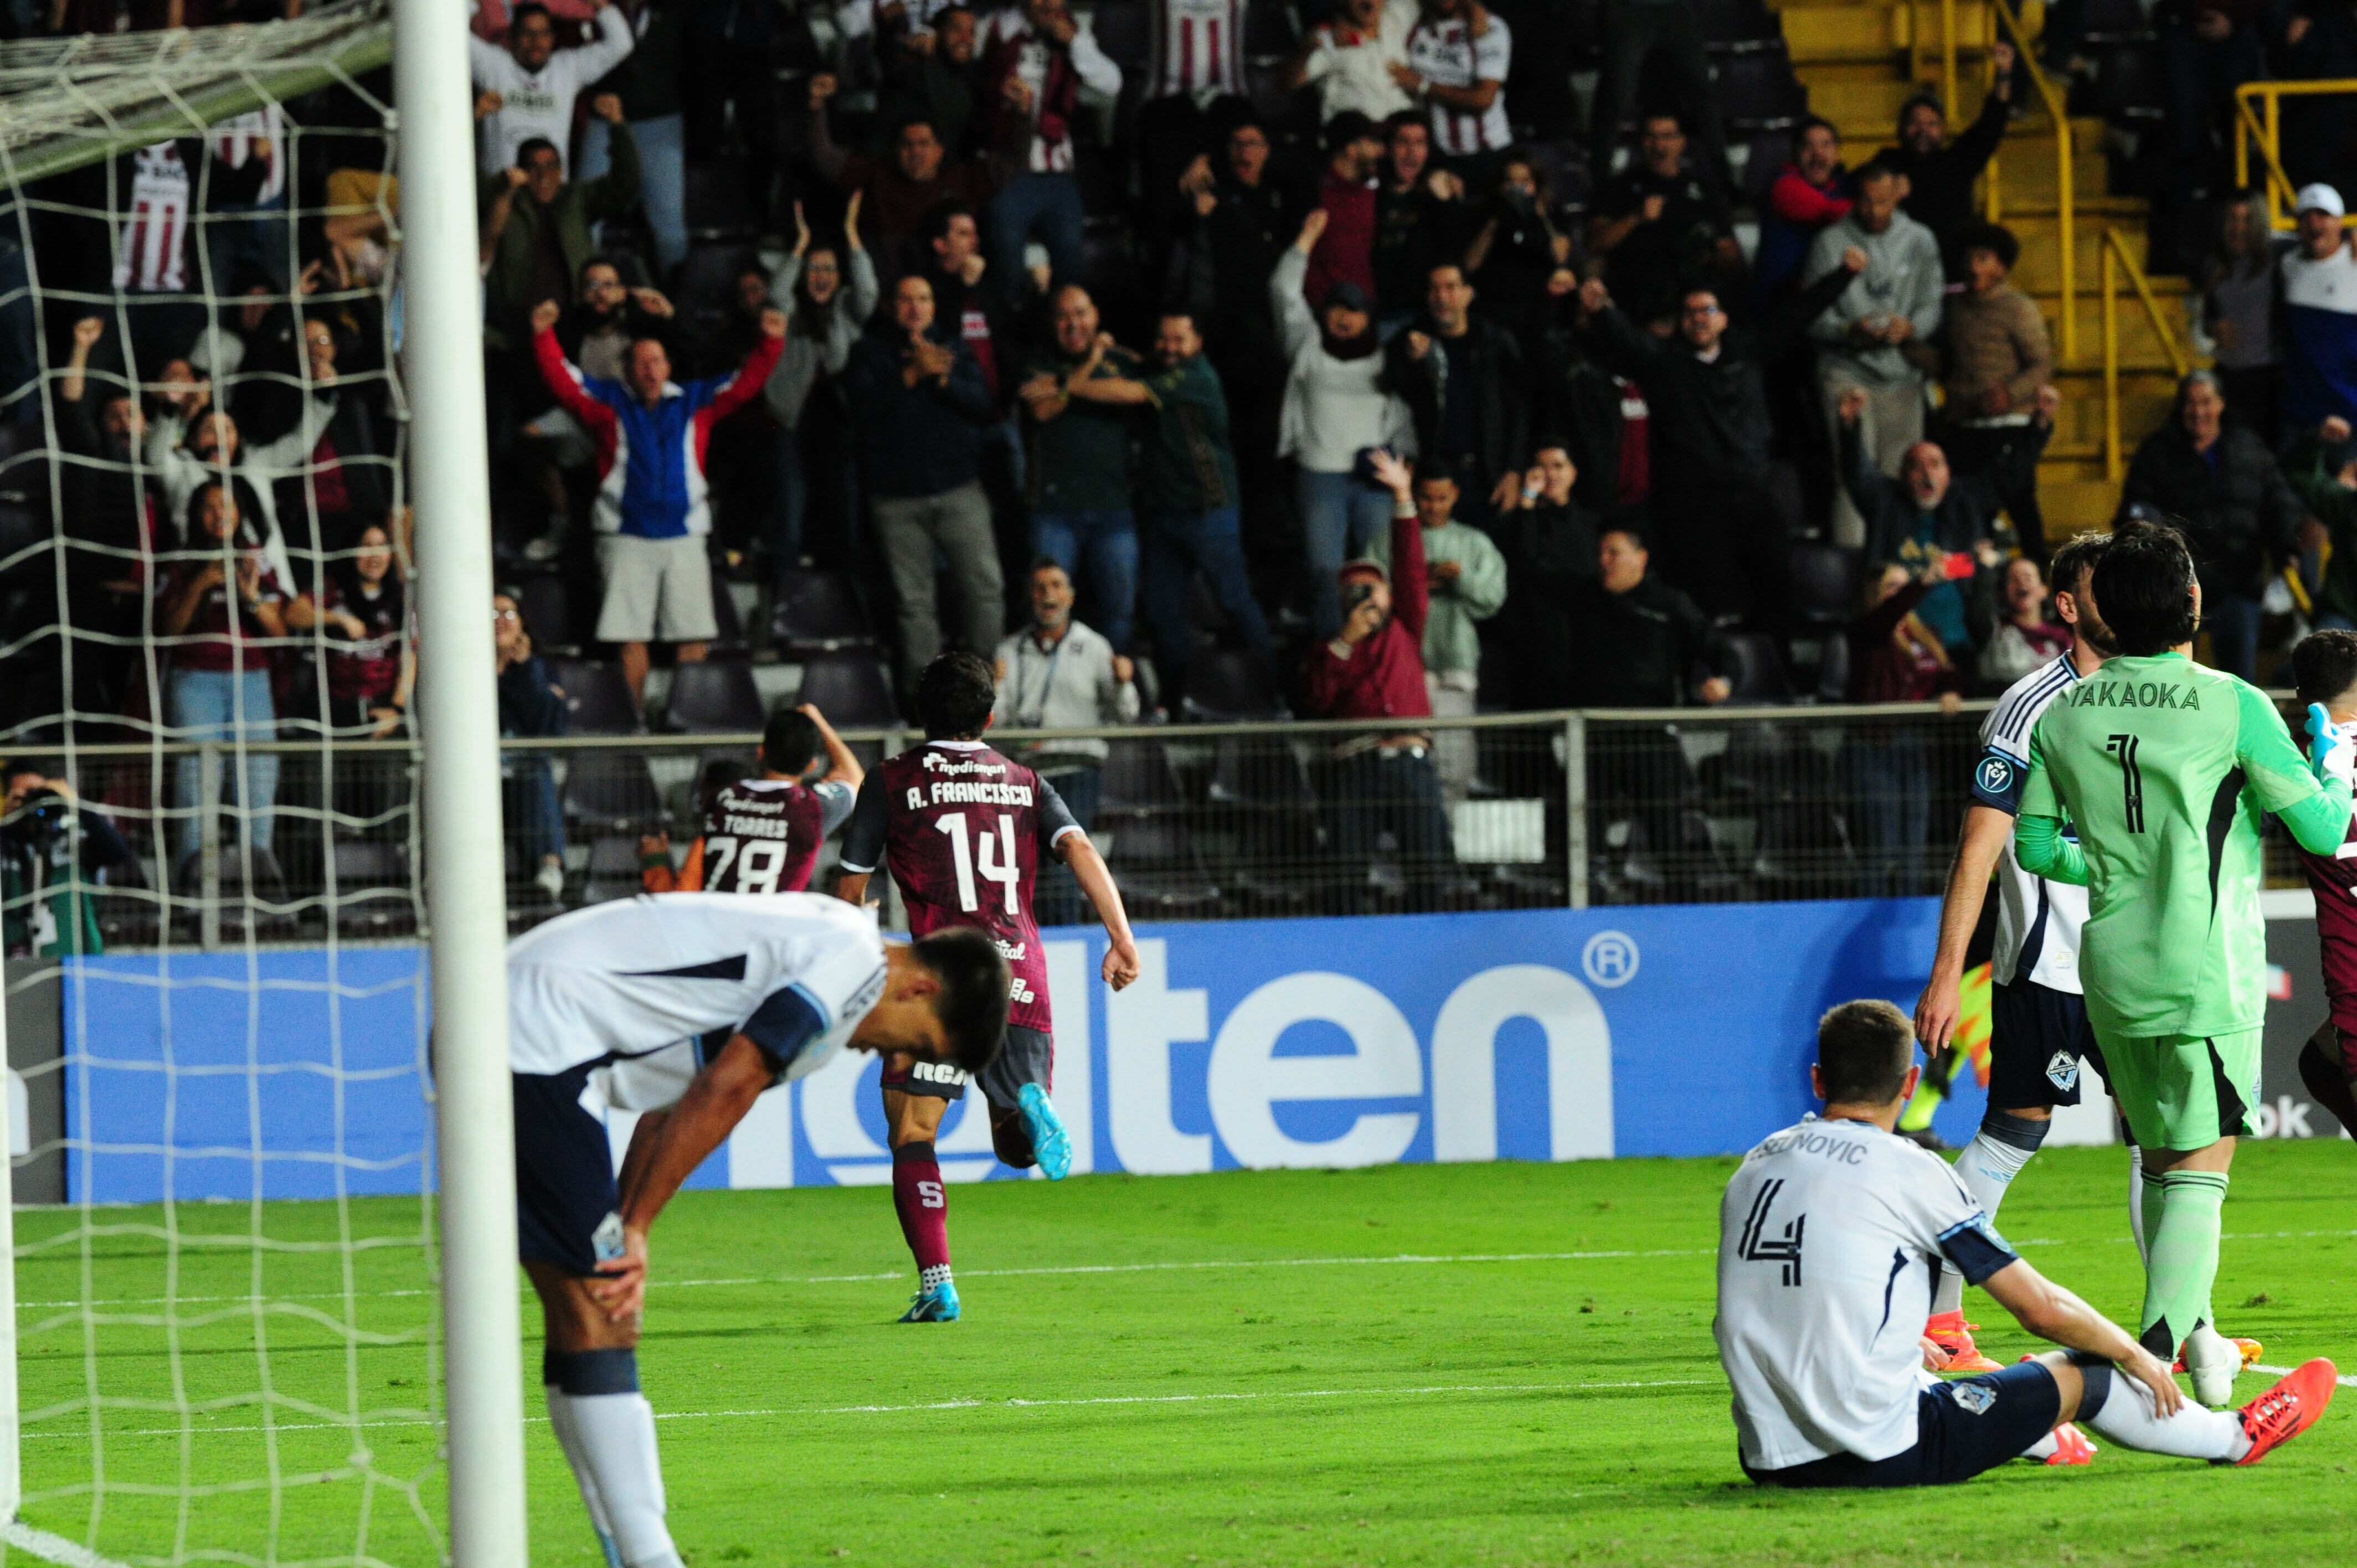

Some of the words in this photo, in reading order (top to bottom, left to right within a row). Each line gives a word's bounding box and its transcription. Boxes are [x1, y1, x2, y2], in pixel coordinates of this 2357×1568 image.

[2071, 681, 2200, 711] TAKAOKA
[907, 787, 928, 810] A.
[931, 782, 1033, 807] FRANCISCO
[2107, 734, 2145, 834] 1
[704, 837, 788, 894] 78
[935, 812, 1020, 915] 14
[1738, 1179, 1806, 1287] 4
